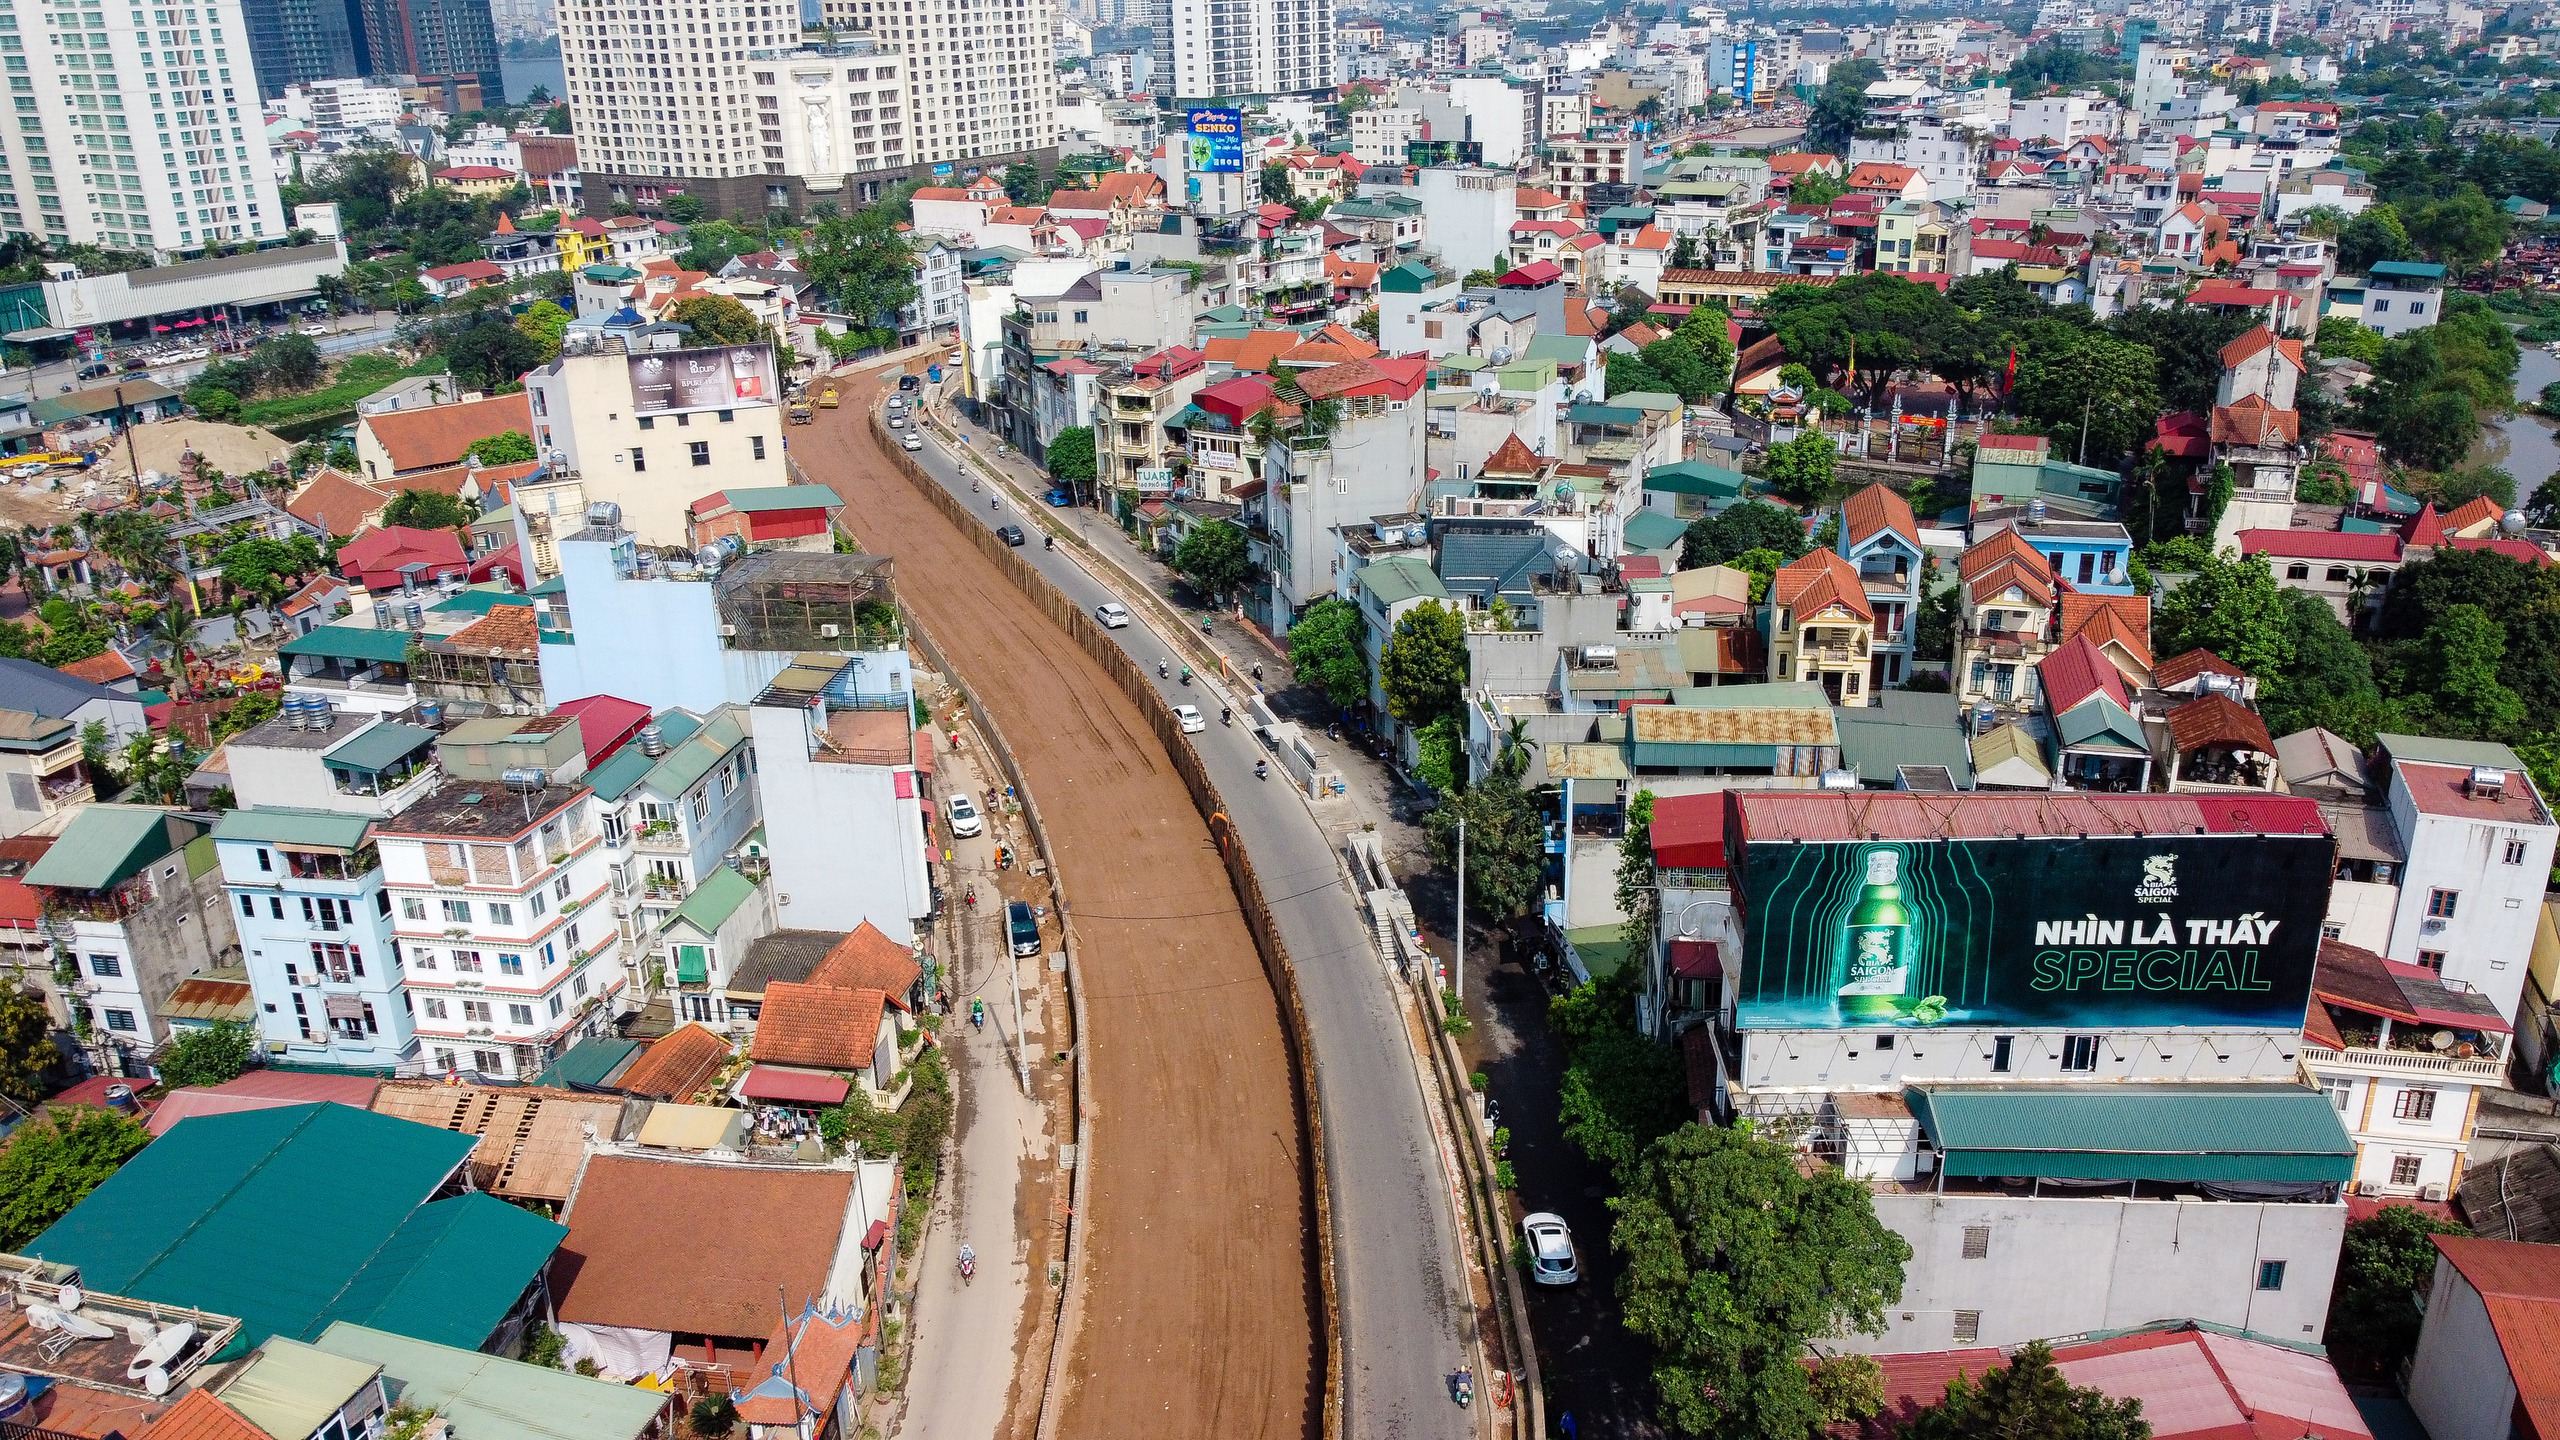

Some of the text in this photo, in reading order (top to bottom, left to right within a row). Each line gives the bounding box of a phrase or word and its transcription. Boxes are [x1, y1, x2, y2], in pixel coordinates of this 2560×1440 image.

[1195, 124, 1236, 133] SENKO
[1137, 471, 1173, 481] TUART
[2134, 887, 2179, 897] SAIGON
[2137, 896, 2173, 904] SPECIAL
[2035, 911, 2280, 946] NHÌN LÀ THẤY
[1850, 966, 1895, 976] SAIGON
[2030, 950, 2272, 992] SPECIAL
